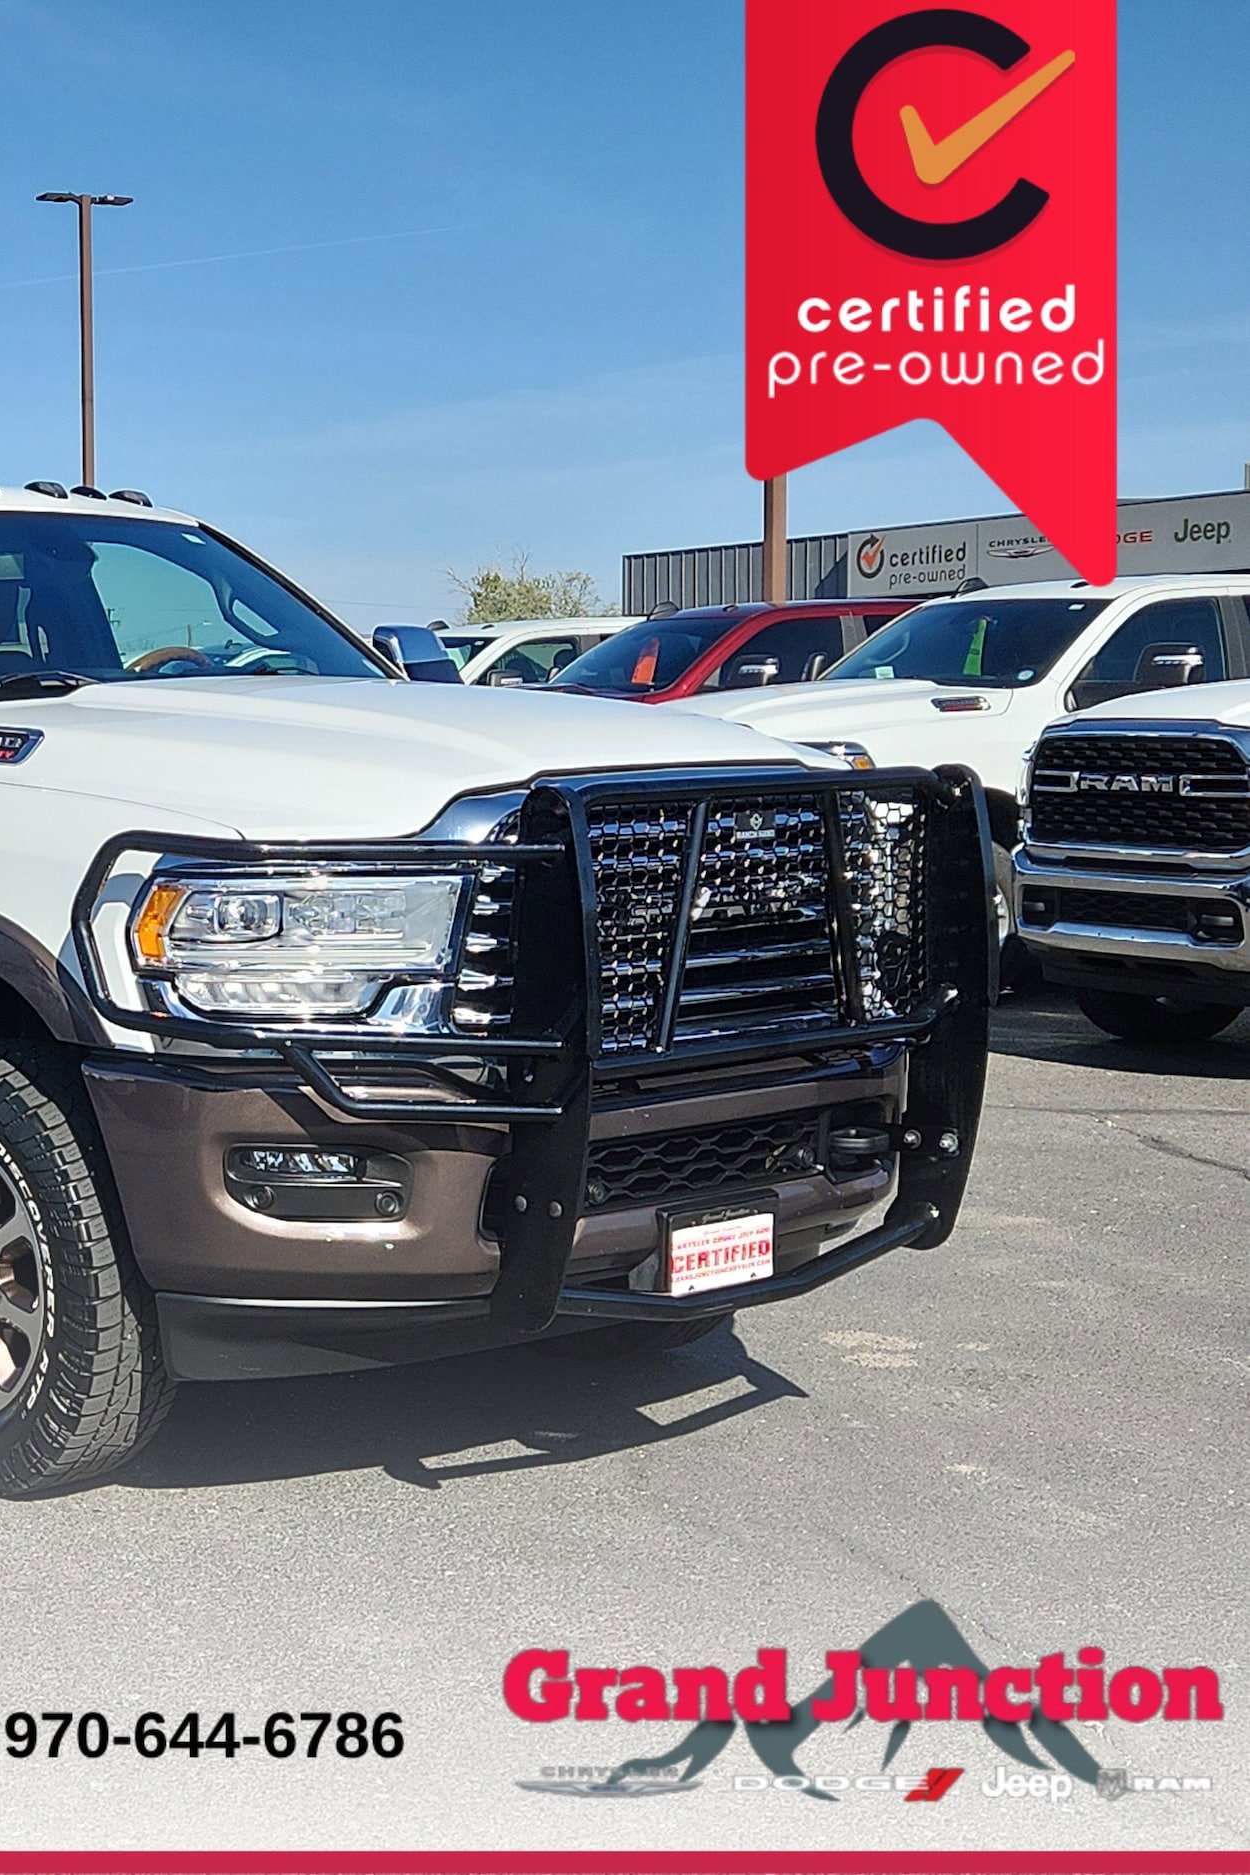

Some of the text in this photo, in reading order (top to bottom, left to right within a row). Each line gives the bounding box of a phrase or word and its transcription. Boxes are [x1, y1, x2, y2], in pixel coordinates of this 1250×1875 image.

[989, 535, 1050, 549] CHRYSLE
[1174, 518, 1230, 544] Jeep
[889, 541, 966, 567] certified
[889, 564, 966, 590] pre-owned
[1079, 772, 1174, 793] RAM
[671, 1239, 770, 1274] CERTIFIED
